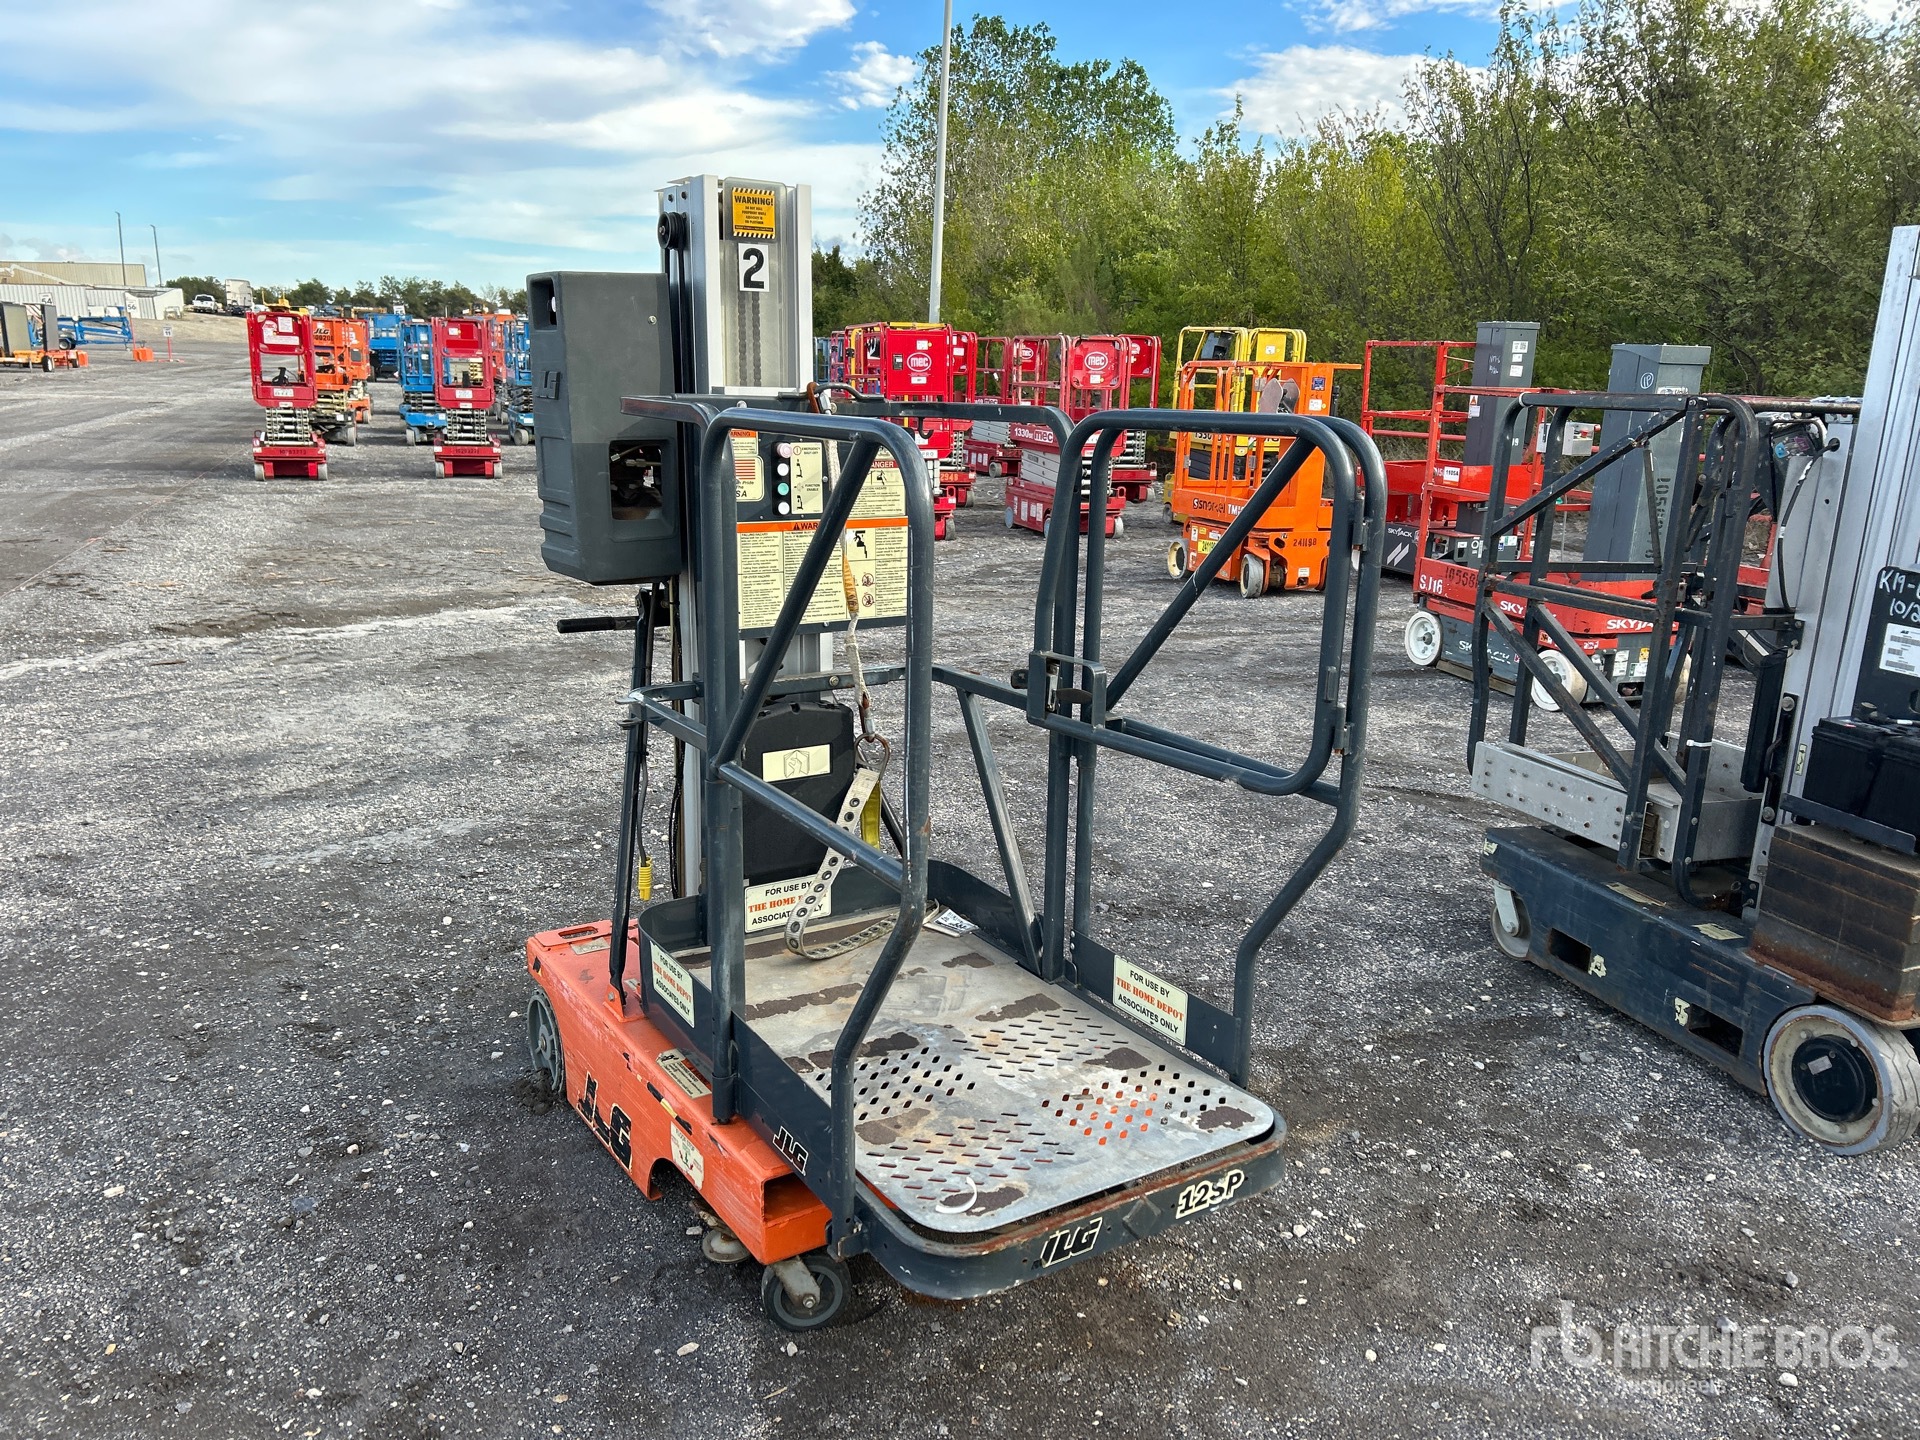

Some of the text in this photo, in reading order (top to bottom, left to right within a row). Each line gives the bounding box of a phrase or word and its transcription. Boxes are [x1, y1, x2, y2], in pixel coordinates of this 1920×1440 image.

[734, 195, 774, 206] WARNING!
[742, 247, 765, 289] 2
[1033, 430, 1053, 443] mec
[1387, 527, 1413, 538] SKYJACK
[765, 881, 812, 896] FOR USE BY
[748, 902, 768, 913] THE
[769, 896, 796, 909] HOME
[751, 910, 791, 925] ASSOCIAT
[1129, 970, 1170, 998] FOR USE BY
[1116, 976, 1185, 1022] THE HOME DEPOT
[1118, 993, 1179, 1034] ASSOCIATES ONLY
[773, 1125, 809, 1176] JLG
